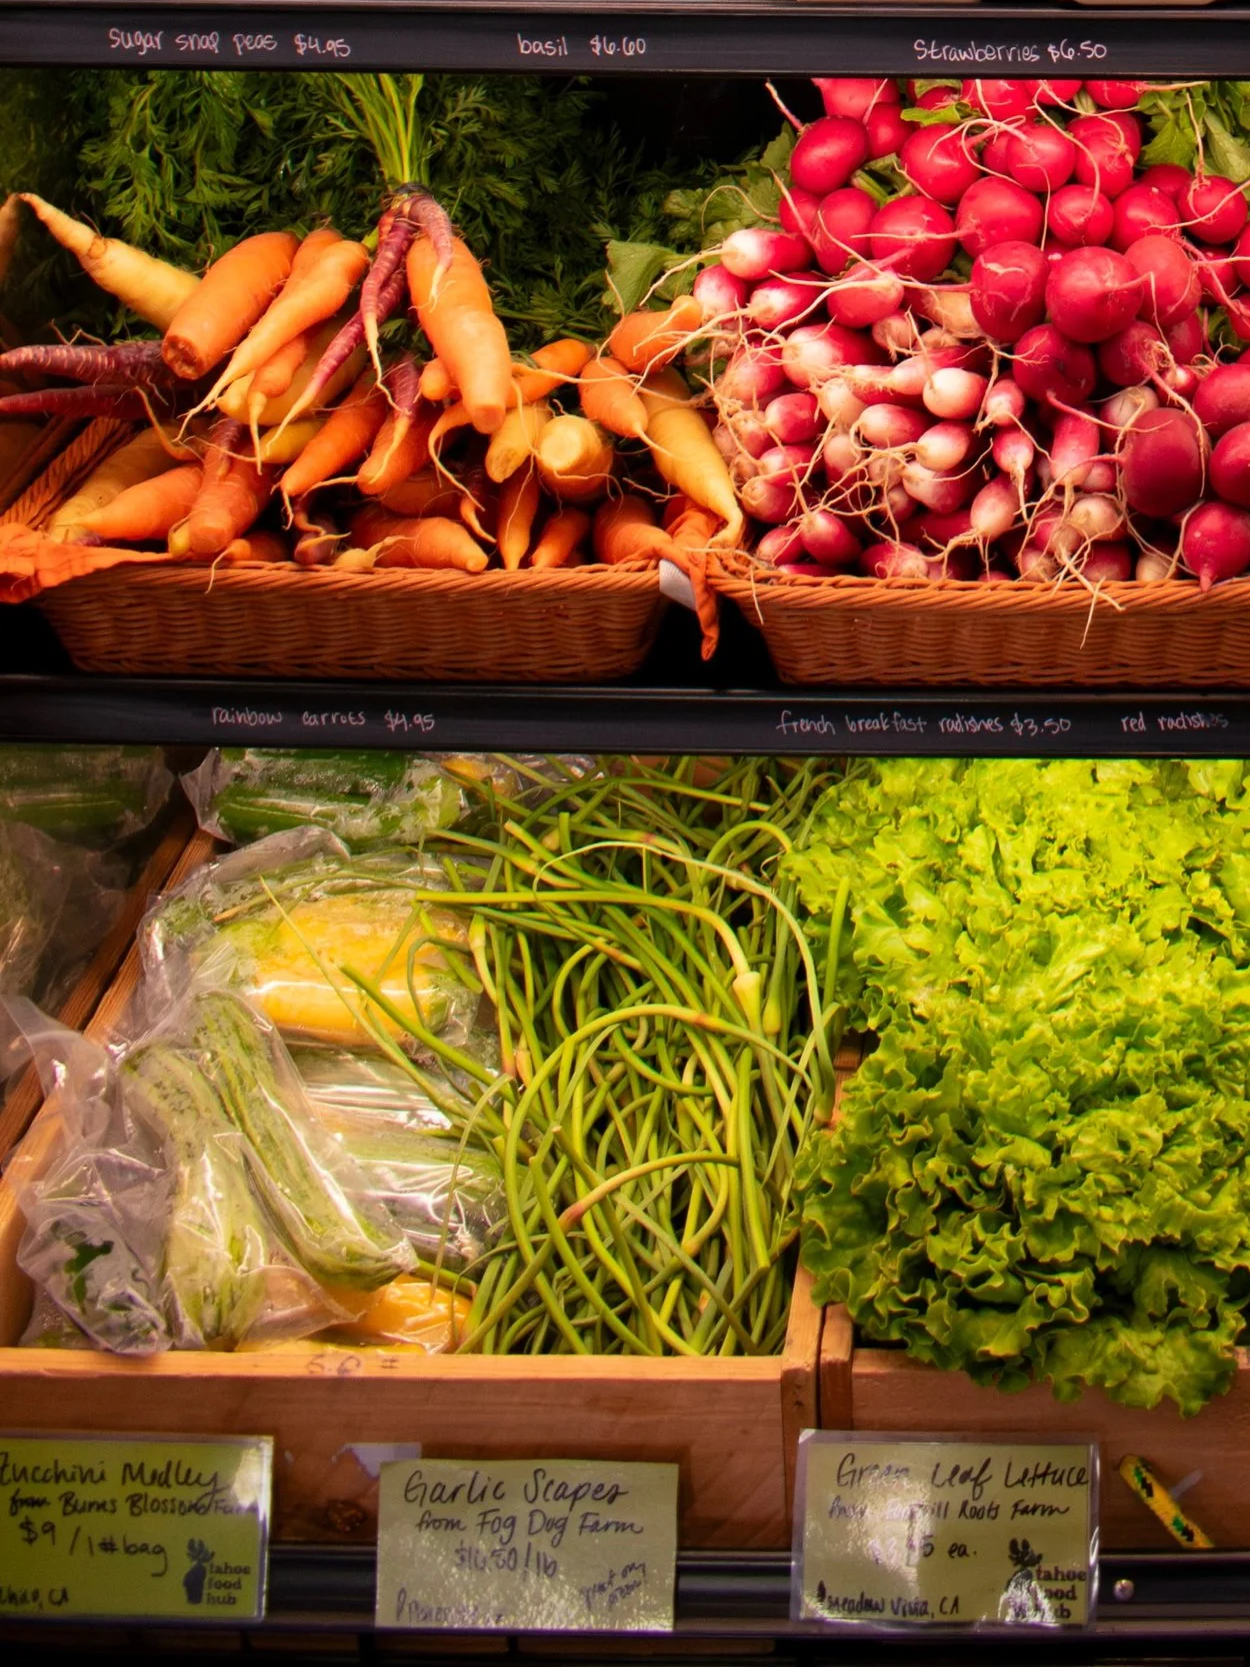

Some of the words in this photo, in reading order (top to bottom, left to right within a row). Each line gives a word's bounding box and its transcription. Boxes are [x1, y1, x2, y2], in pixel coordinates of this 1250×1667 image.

[294, 33, 352, 58] $4.95
[517, 32, 569, 57] basil
[590, 34, 647, 56] $6.60
[1047, 38, 1108, 64] $6.50
[211, 707, 284, 726] rainbow
[302, 709, 367, 727] carrots
[384, 708, 436, 732] $4.95
[776, 709, 836, 736] french
[1010, 712, 1073, 737] $3.50
[1121, 712, 1147, 733] red
[1005, 1460, 1090, 1489] Lettuce
[404, 1469, 506, 1507] Garlic
[958, 1500, 1000, 1521] Roots
[1012, 1498, 1071, 1521] Farm
[475, 1508, 517, 1545] Fog
[528, 1508, 570, 1548] Dog
[578, 1511, 645, 1536] Farm
[1036, 1565, 1089, 1582] tahoe
[206, 1591, 238, 1606] hub
[940, 1596, 961, 1616] CA
